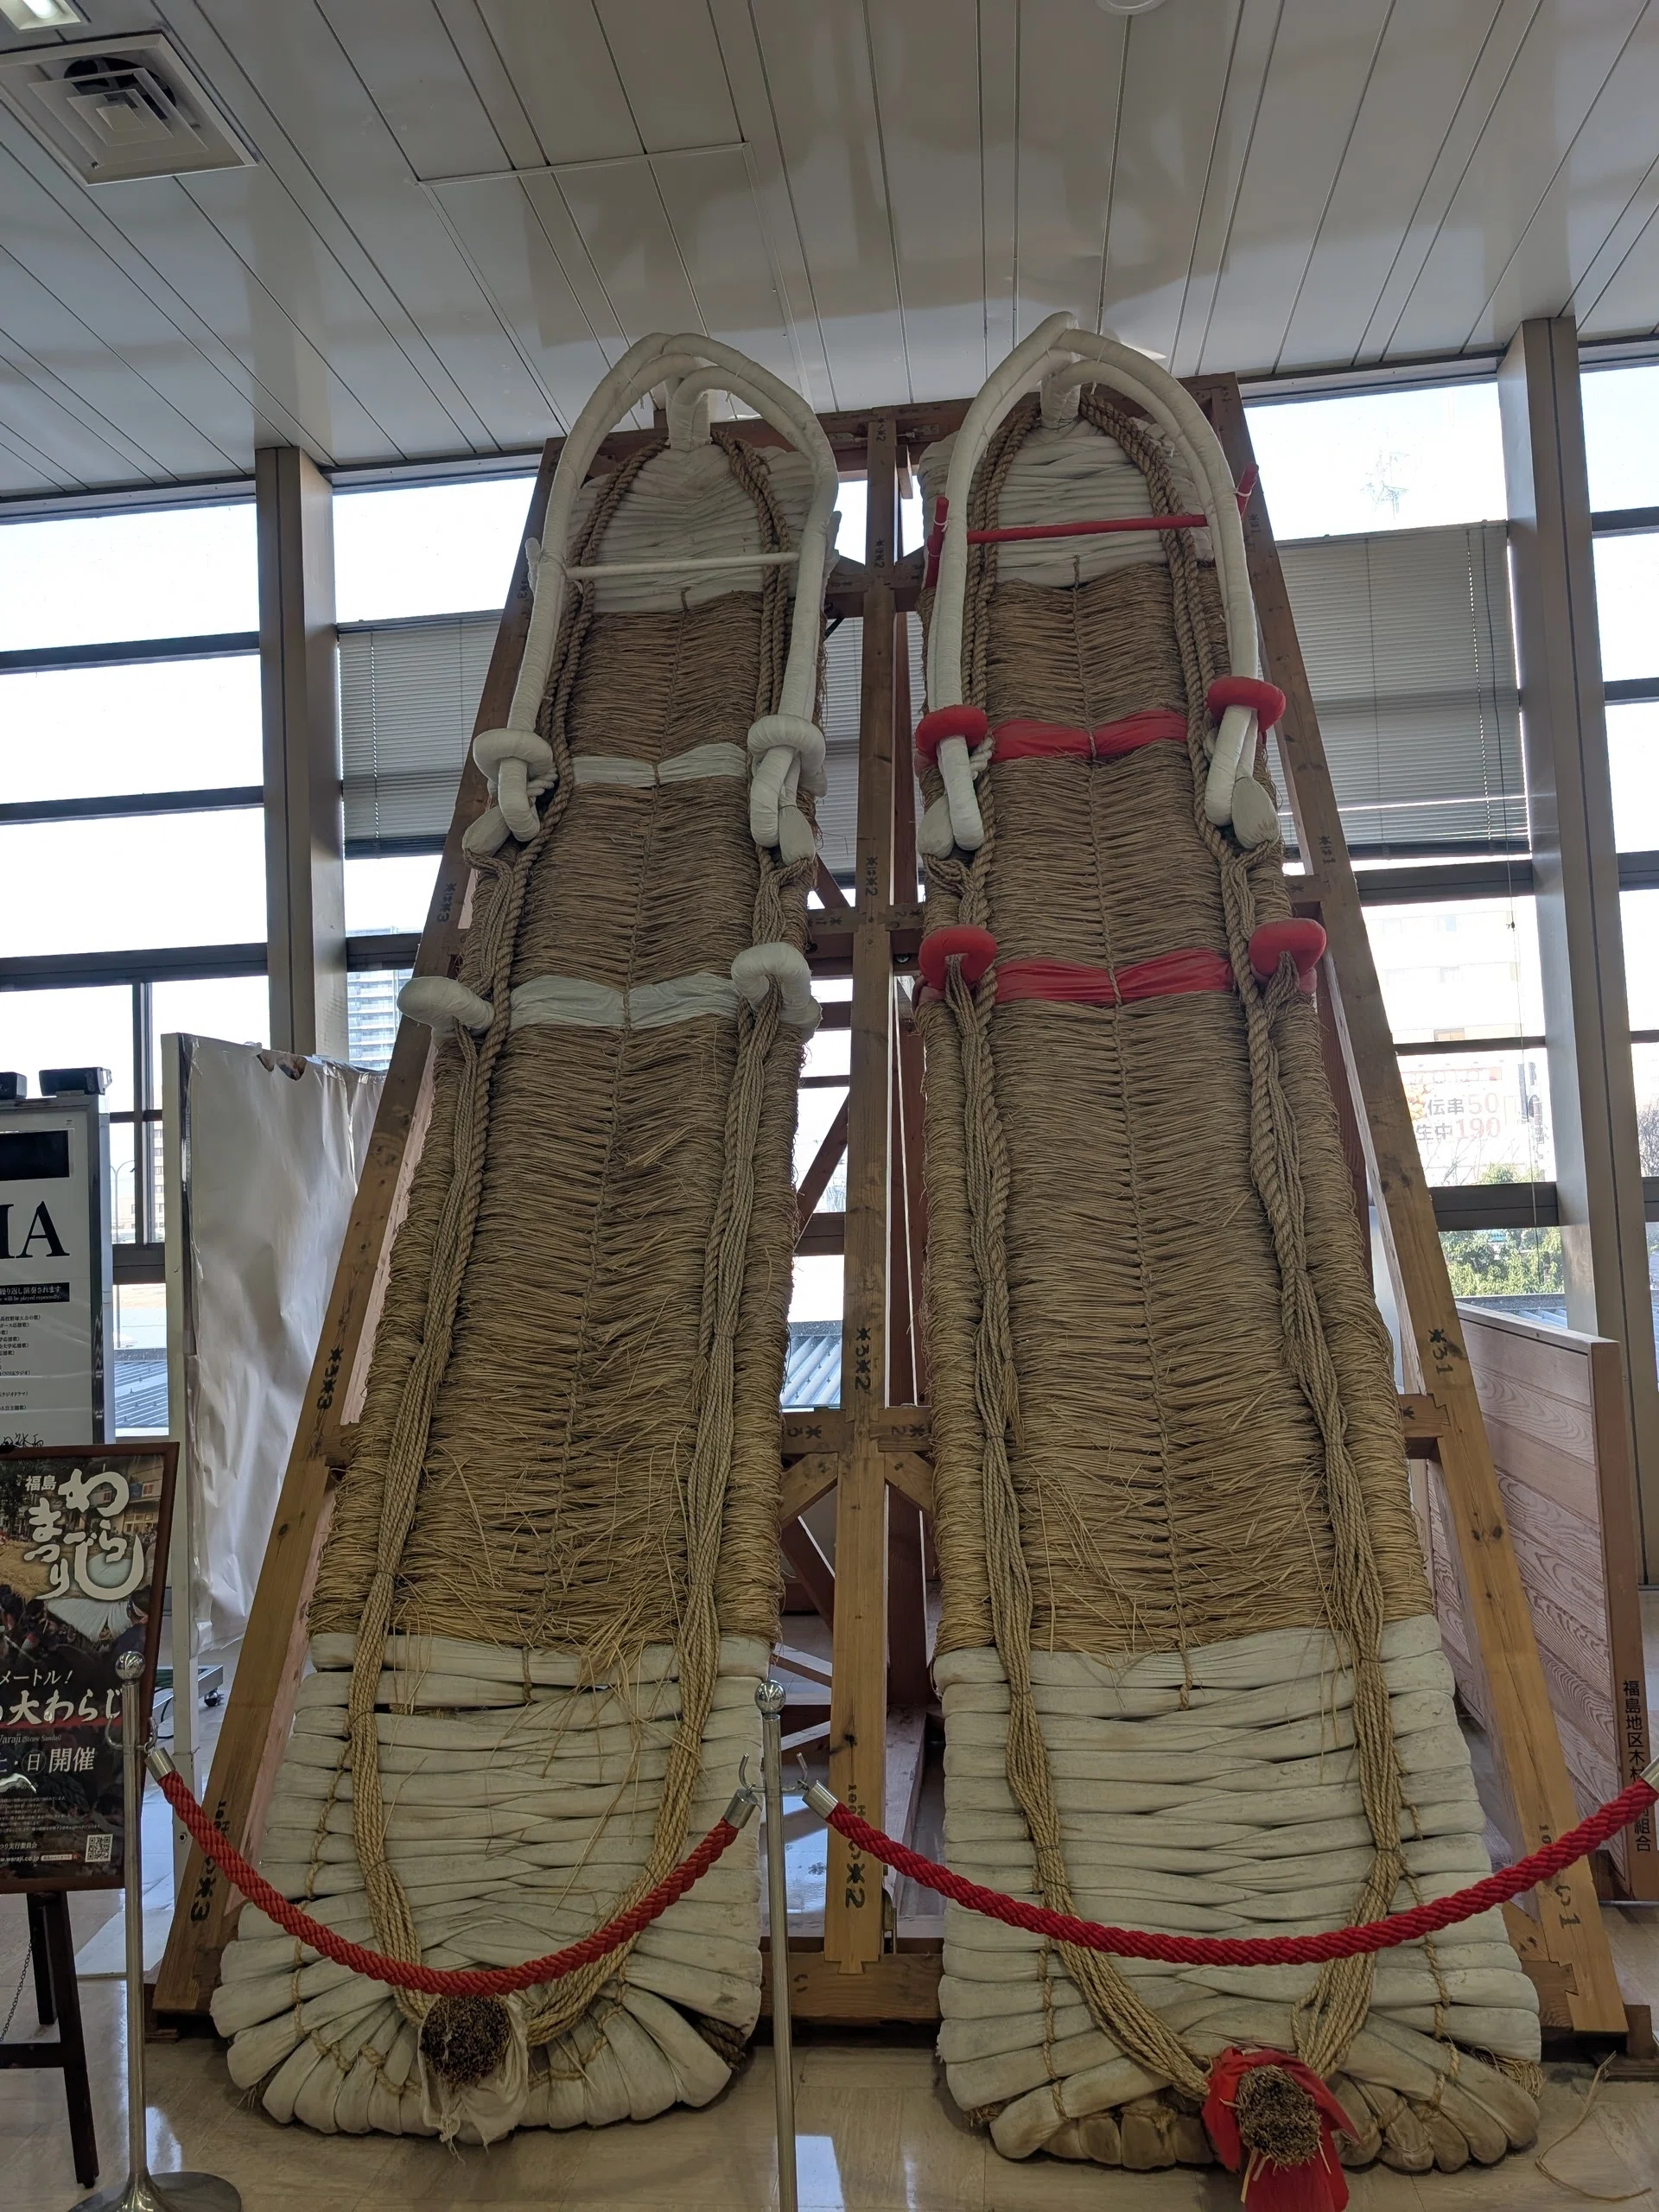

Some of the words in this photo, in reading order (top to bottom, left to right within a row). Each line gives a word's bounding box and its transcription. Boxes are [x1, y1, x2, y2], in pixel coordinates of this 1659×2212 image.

[25, 1475, 57, 1491] 福島
[23, 1497, 69, 1599] まつり
[0, 1688, 123, 1726] 大わらじ
[1623, 1680, 1651, 1853] 福島地区木材組合
